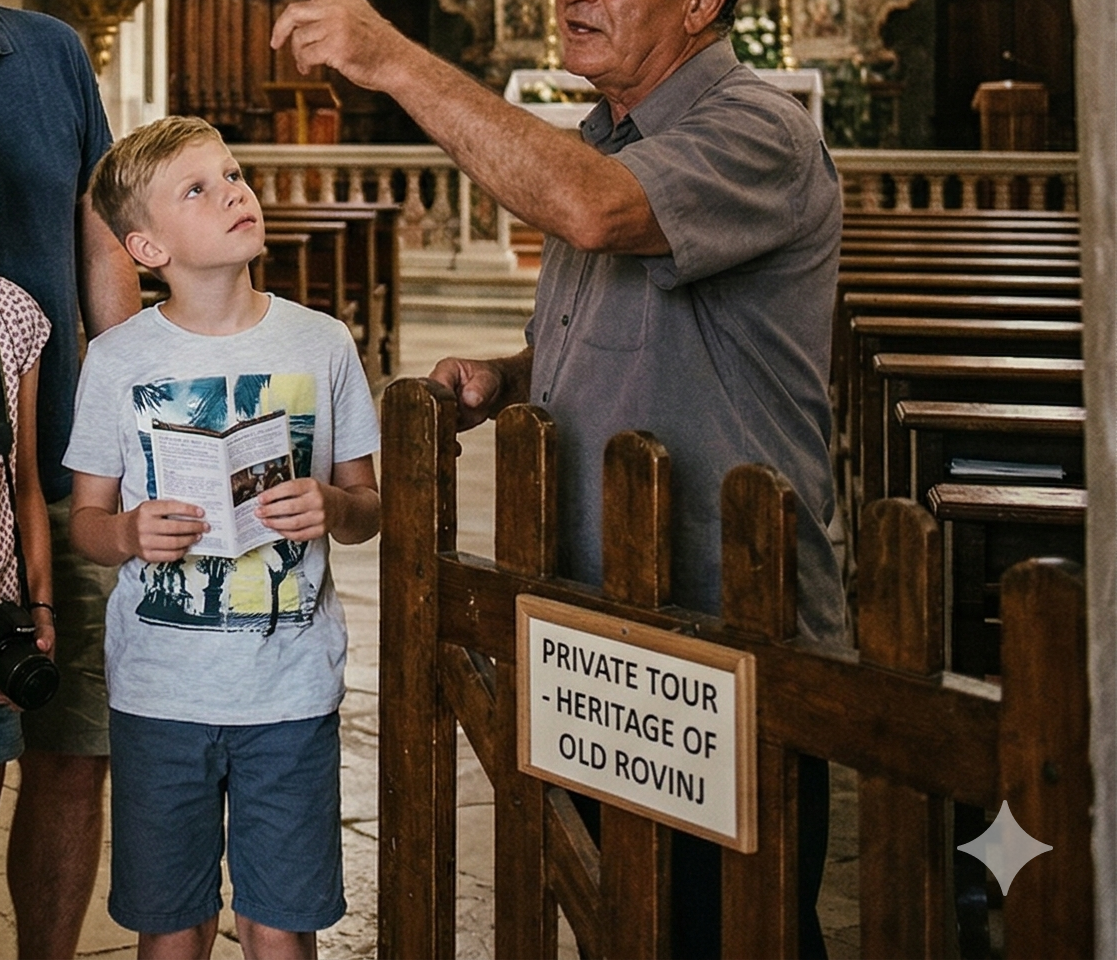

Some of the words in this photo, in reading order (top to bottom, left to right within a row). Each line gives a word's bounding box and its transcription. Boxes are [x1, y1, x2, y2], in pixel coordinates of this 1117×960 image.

[542, 637, 639, 690] PRIVATE
[645, 666, 719, 714] TOUR
[556, 686, 675, 748] HERITAGE
[682, 725, 717, 760] OF
[558, 732, 607, 771] OLD
[614, 749, 706, 806] ROVINJ
